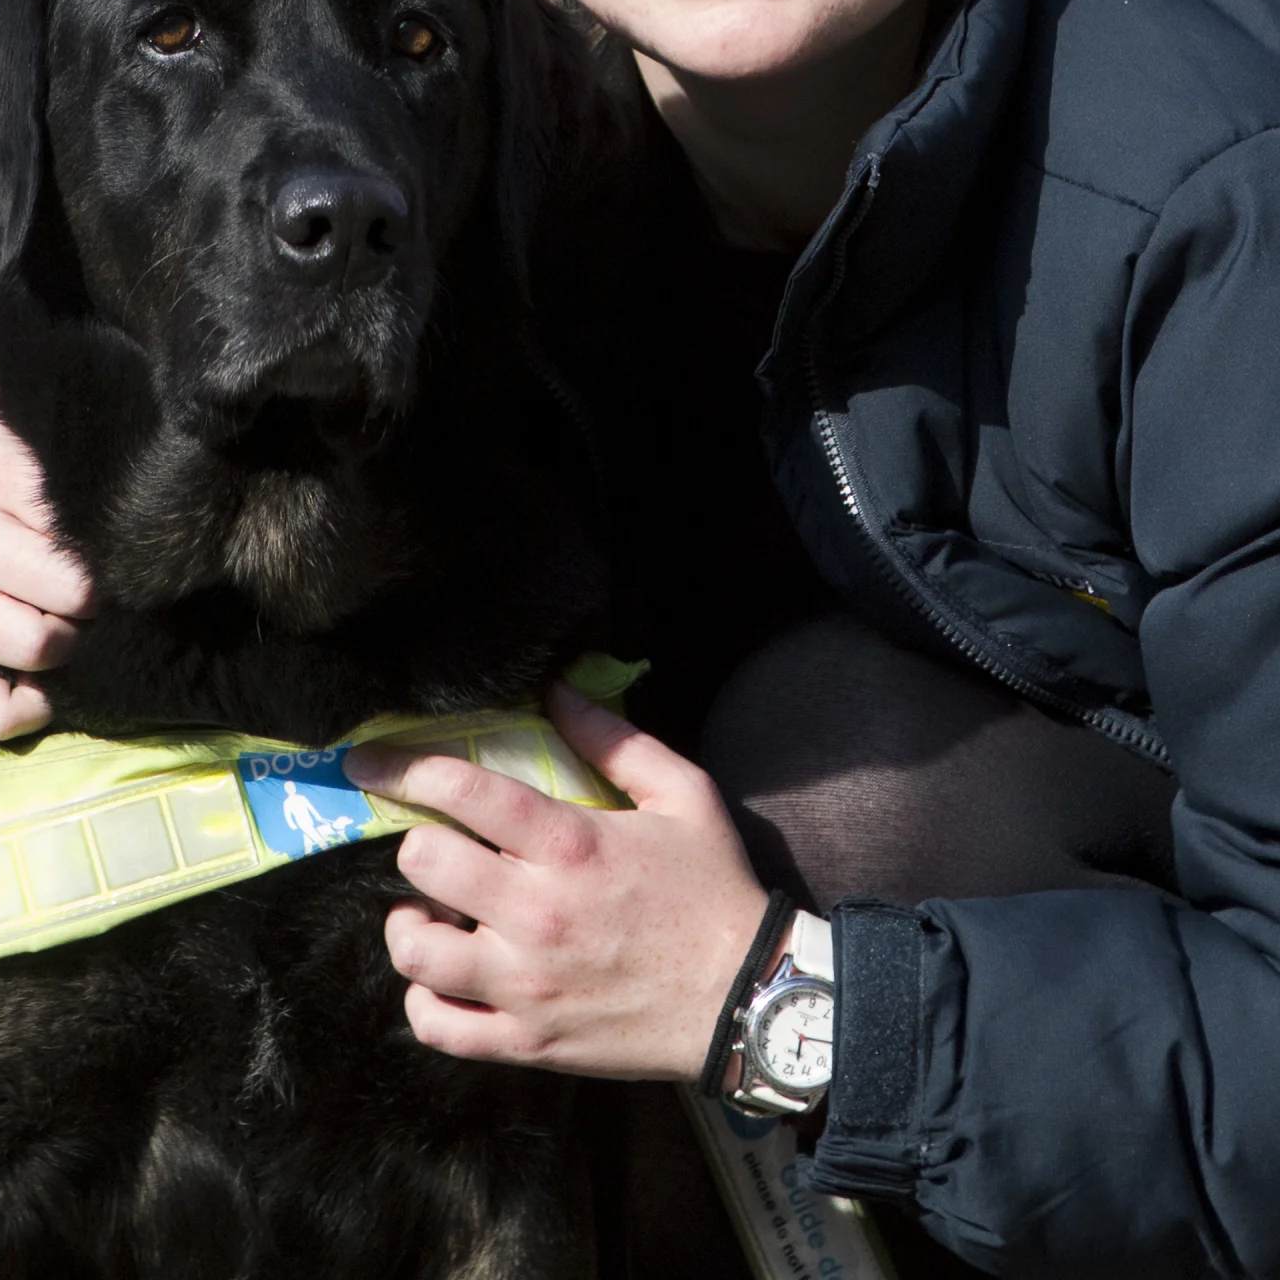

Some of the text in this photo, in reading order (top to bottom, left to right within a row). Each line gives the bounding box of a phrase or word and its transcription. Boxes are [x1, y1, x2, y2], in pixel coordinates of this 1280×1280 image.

[249, 749, 337, 781] DOGS
[791, 996, 799, 1008] 5
[808, 997, 817, 1009] 6
[823, 1008, 831, 1019] 7
[762, 1037, 771, 1050] 2
[772, 1054, 778, 1064] 1
[816, 1055, 828, 1068] 10
[782, 1063, 795, 1076] 12
[801, 1064, 812, 1076] 11
[742, 1151, 777, 1211] please
[772, 1215, 788, 1240] do
[783, 1244, 806, 1274] not
